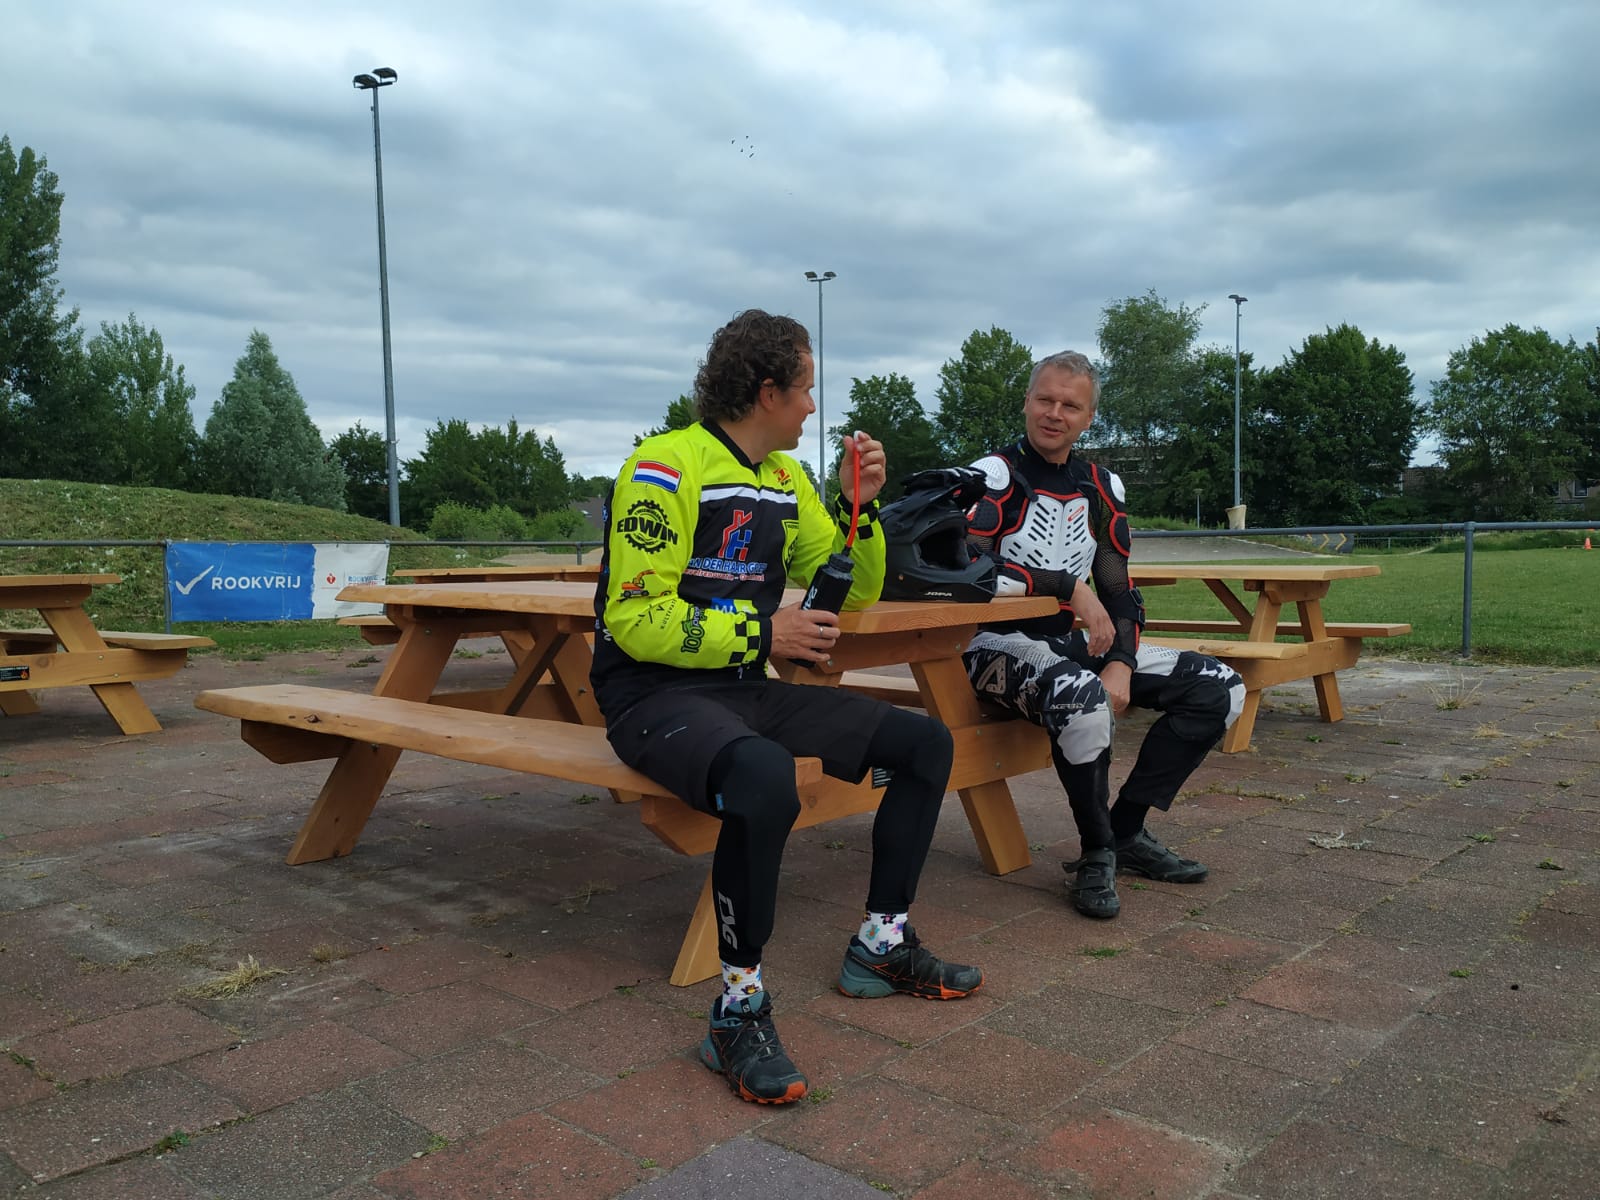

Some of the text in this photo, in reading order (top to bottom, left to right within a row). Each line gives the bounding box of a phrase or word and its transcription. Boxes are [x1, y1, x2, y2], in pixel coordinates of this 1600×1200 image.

[617, 516, 678, 545] EDWIN
[703, 557, 722, 570] DER
[211, 575, 301, 590] ROOKVRIJ
